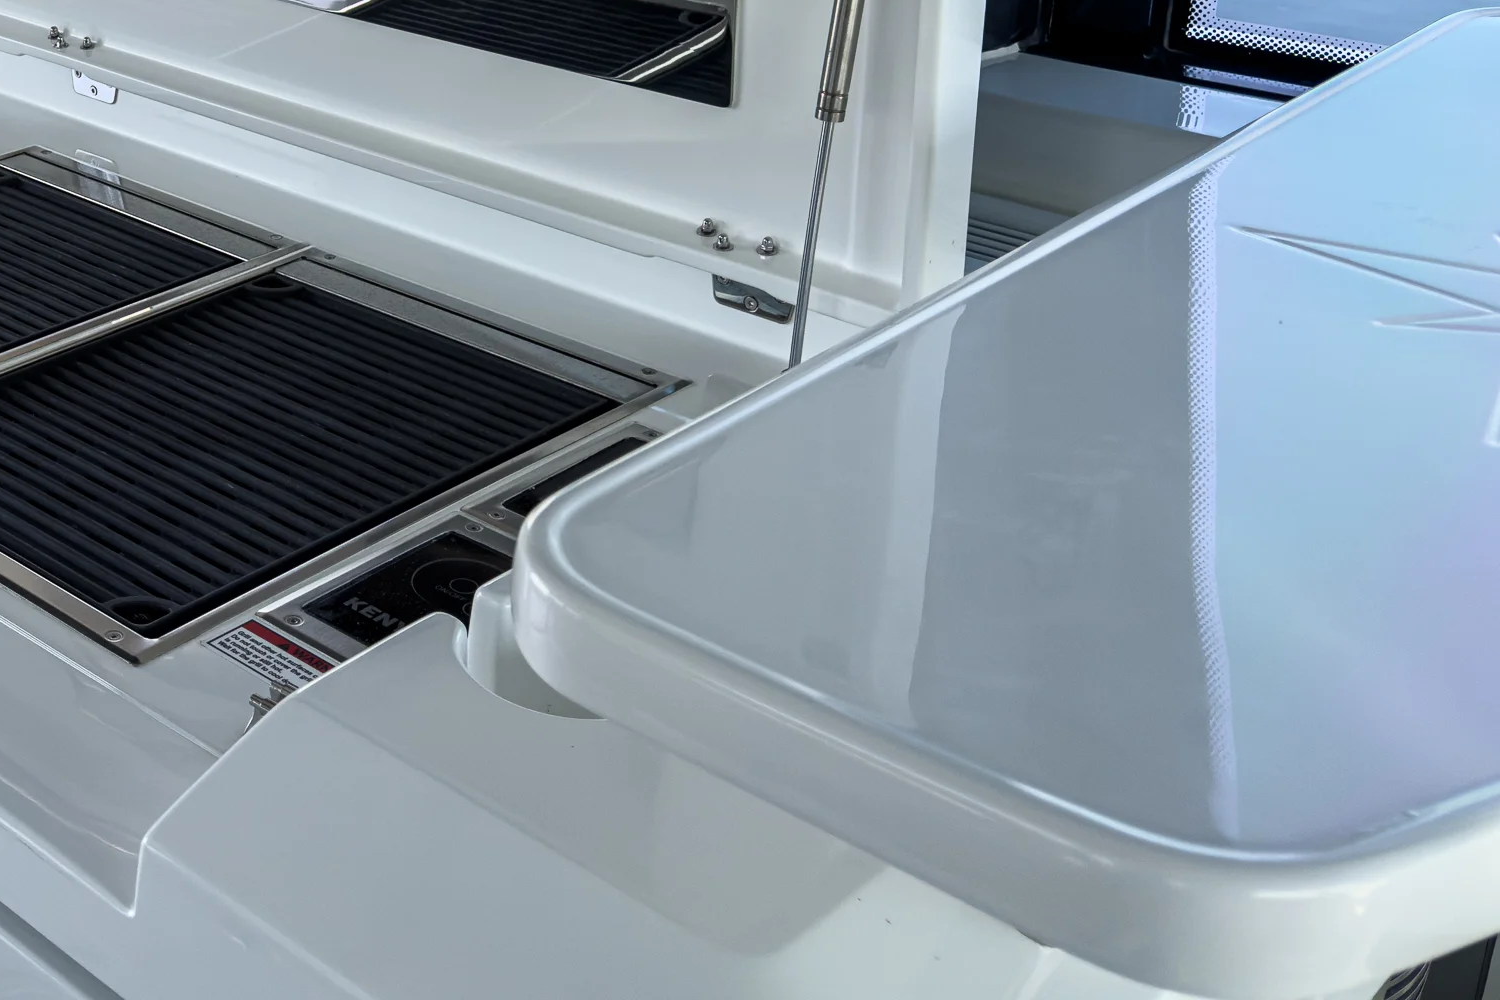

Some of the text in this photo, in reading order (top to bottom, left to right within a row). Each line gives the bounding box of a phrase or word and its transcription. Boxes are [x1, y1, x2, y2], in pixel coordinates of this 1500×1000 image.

[218, 640, 232, 650] Wait
[248, 659, 262, 668] grill
[268, 670, 283, 679] cool
[230, 641, 253, 656] running
[259, 658, 273, 666] still
[231, 633, 240, 641] Do
[239, 639, 251, 647] not
[249, 645, 267, 656] touch
[273, 659, 291, 670] cover
[290, 668, 301, 677] the
[238, 630, 314, 676] Grill and other hot surfaces
